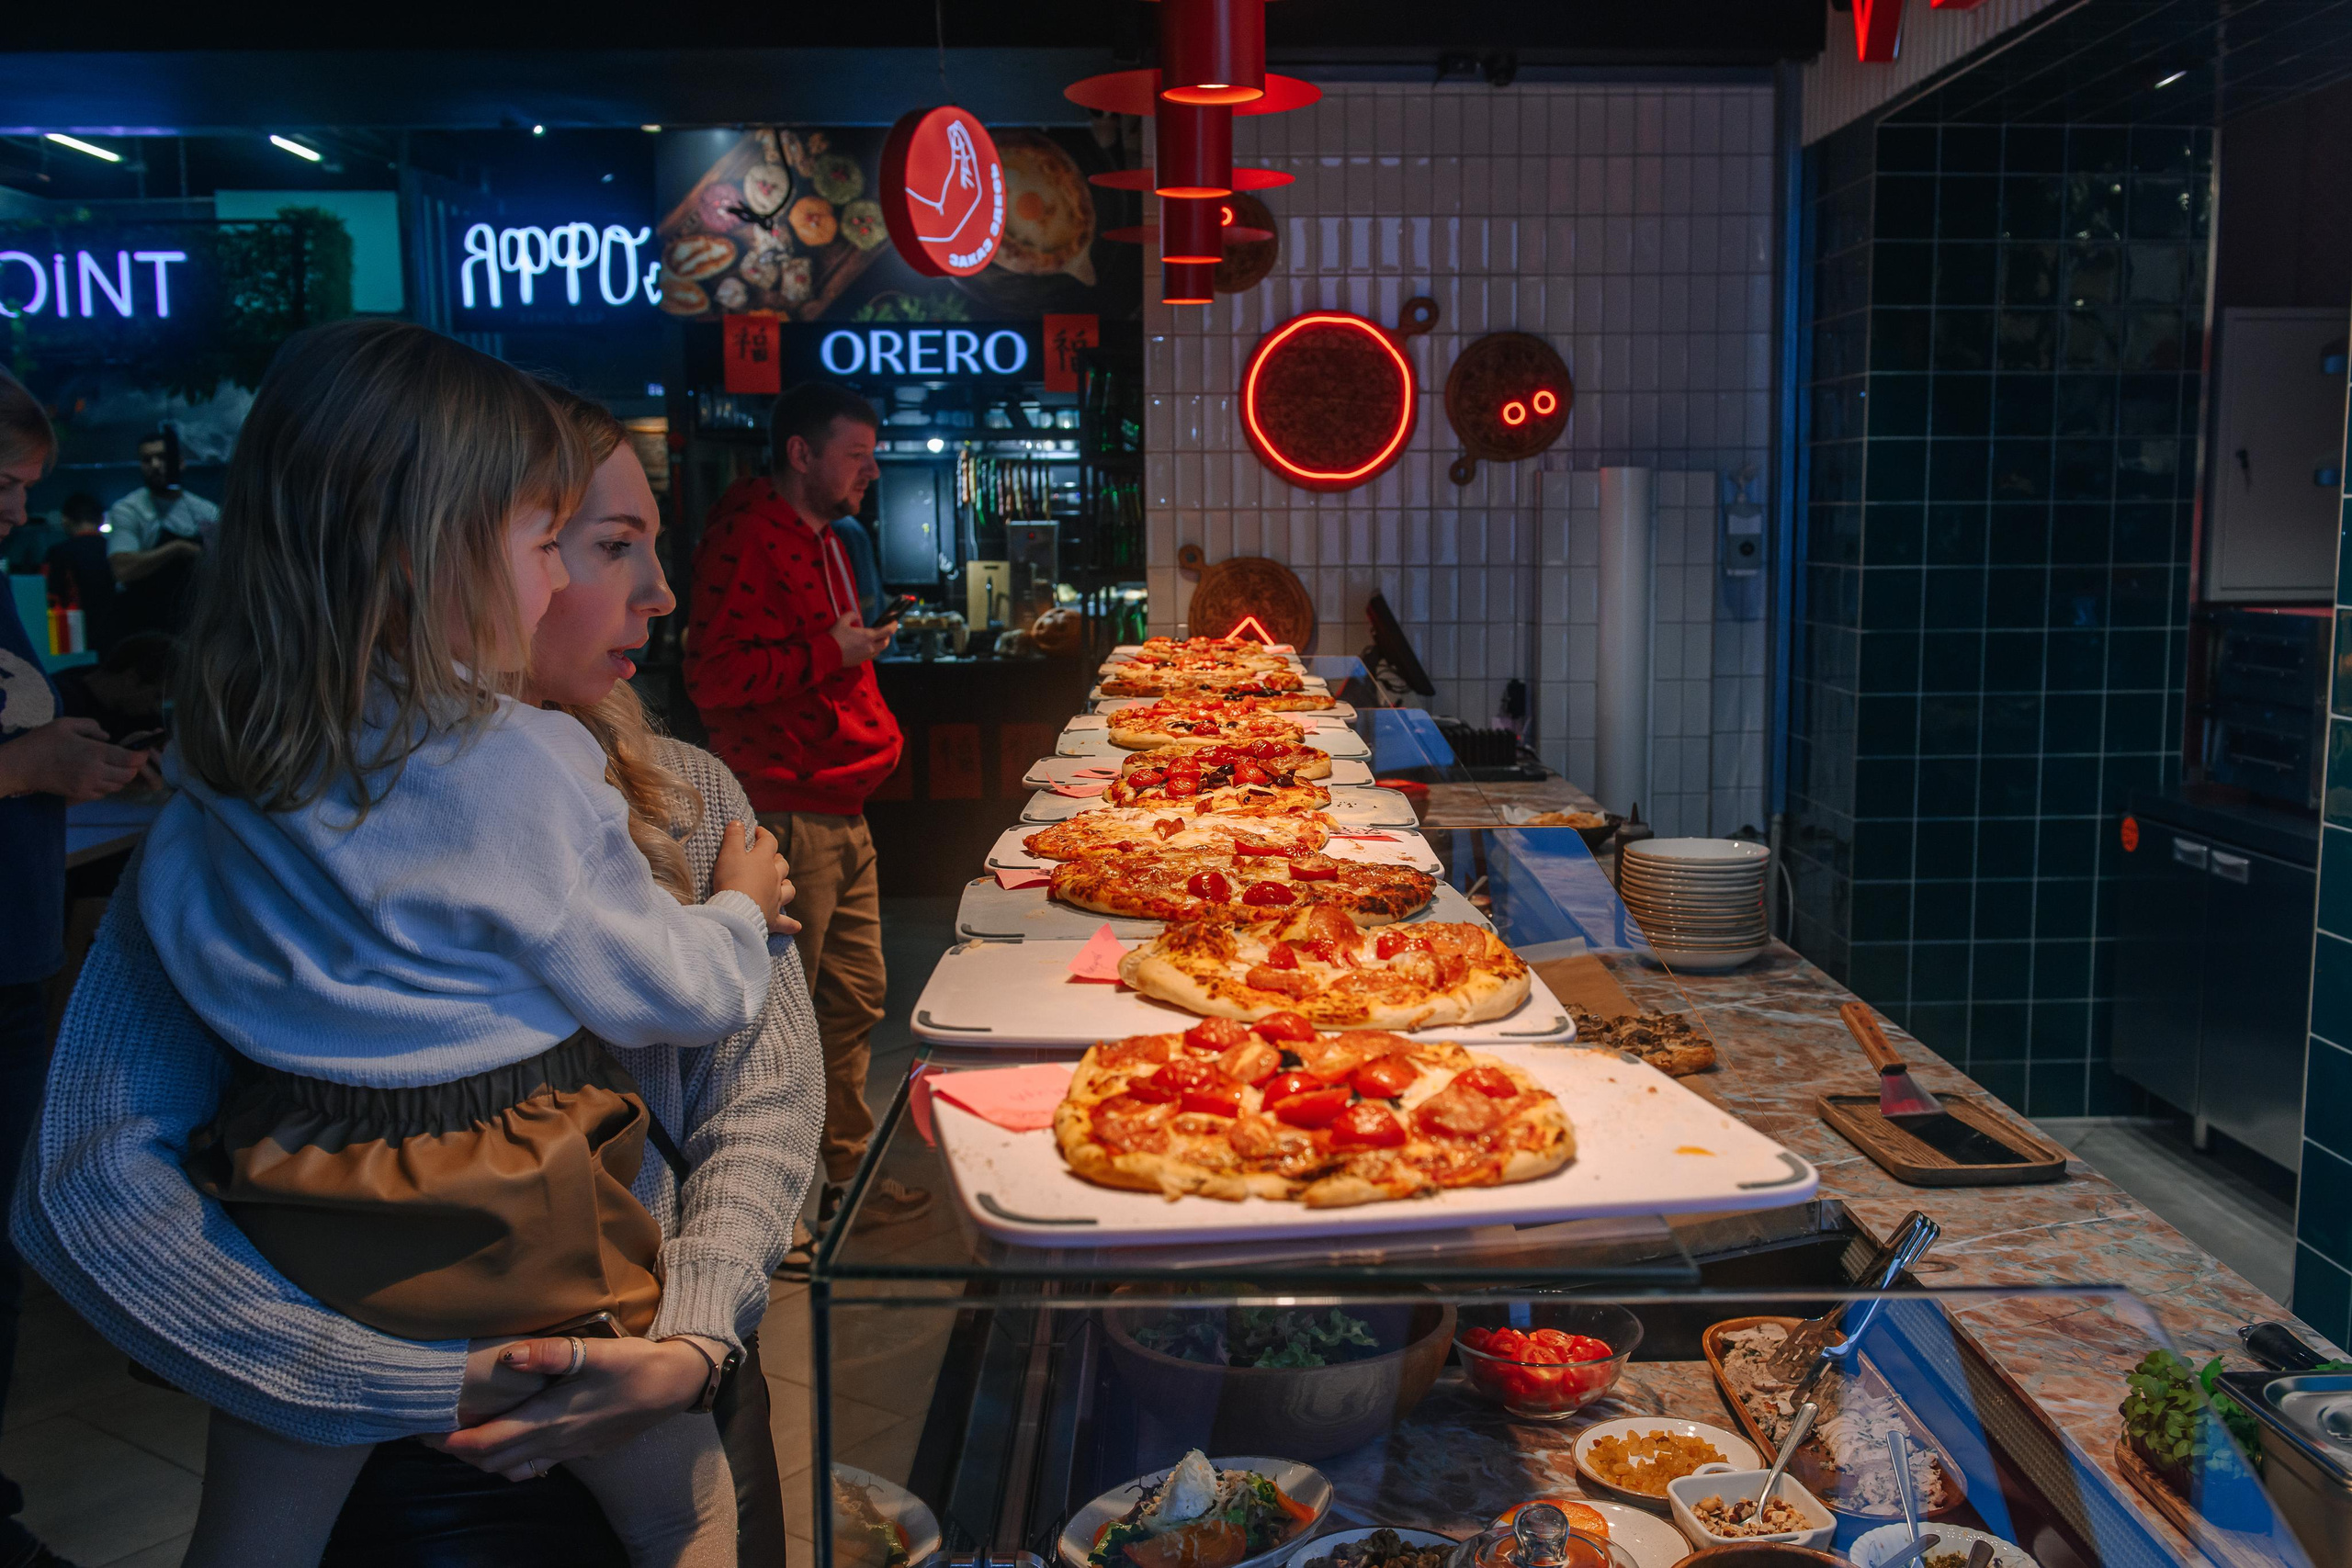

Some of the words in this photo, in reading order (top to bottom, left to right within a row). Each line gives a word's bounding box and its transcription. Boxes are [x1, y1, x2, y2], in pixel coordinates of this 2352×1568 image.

[948, 238, 993, 268] ЗАКАЗ
[990, 163, 1004, 237] ЗДЕСЬ
[820, 329, 1029, 376] ORERO
